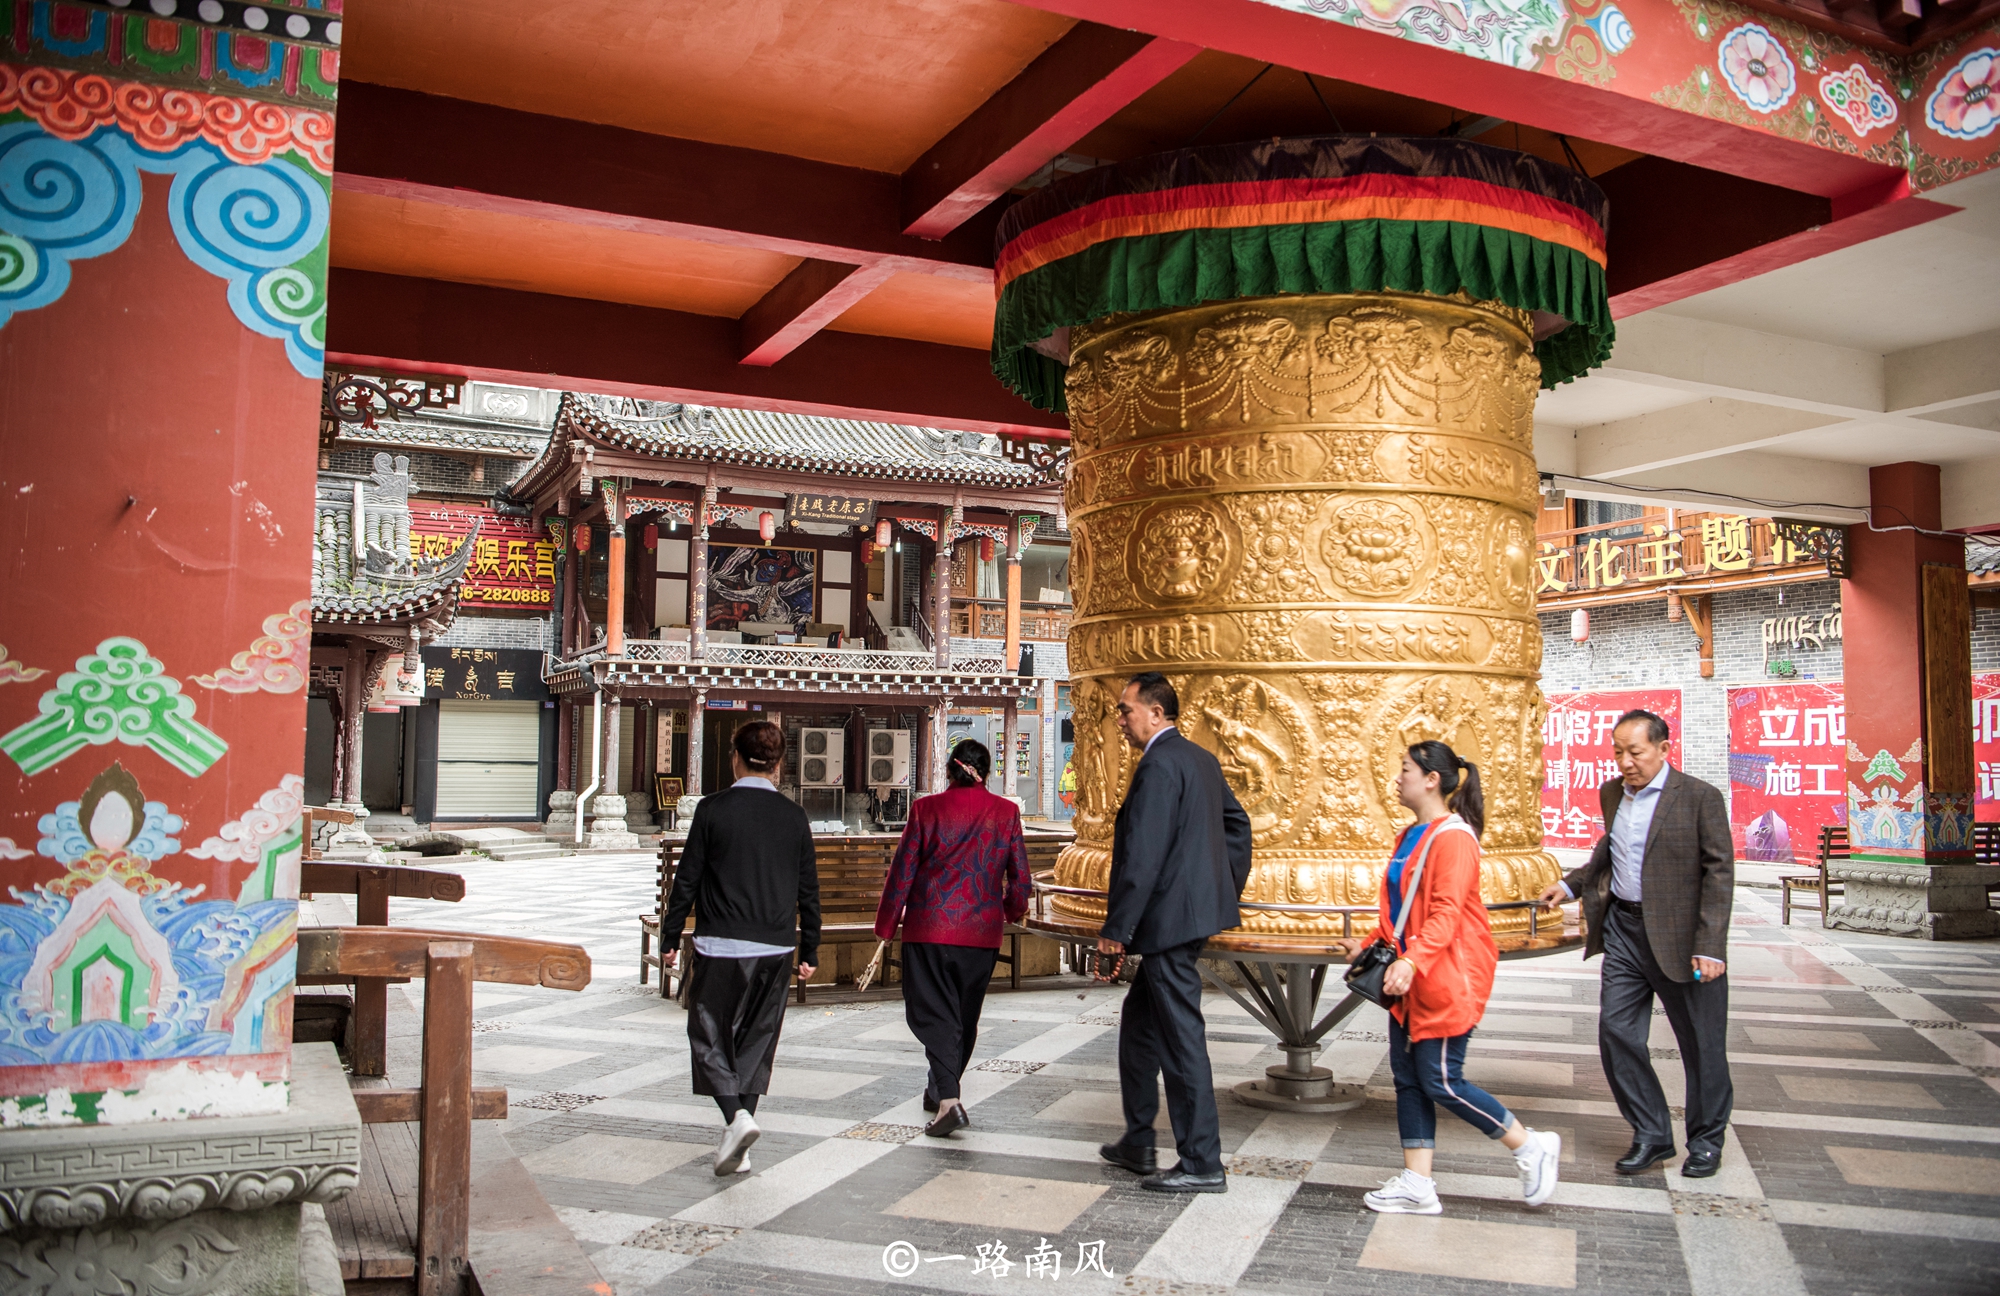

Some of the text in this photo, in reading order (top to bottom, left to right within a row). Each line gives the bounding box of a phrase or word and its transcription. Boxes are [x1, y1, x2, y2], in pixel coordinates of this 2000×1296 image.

[801, 511, 821, 519] Xi-Kang
[821, 512, 847, 520] Traditional
[456, 691, 491, 701] NorGye
[1541, 709, 1624, 746] 即将开
[1546, 759, 1623, 789] 请勿进
[1765, 762, 1846, 796] 施工
